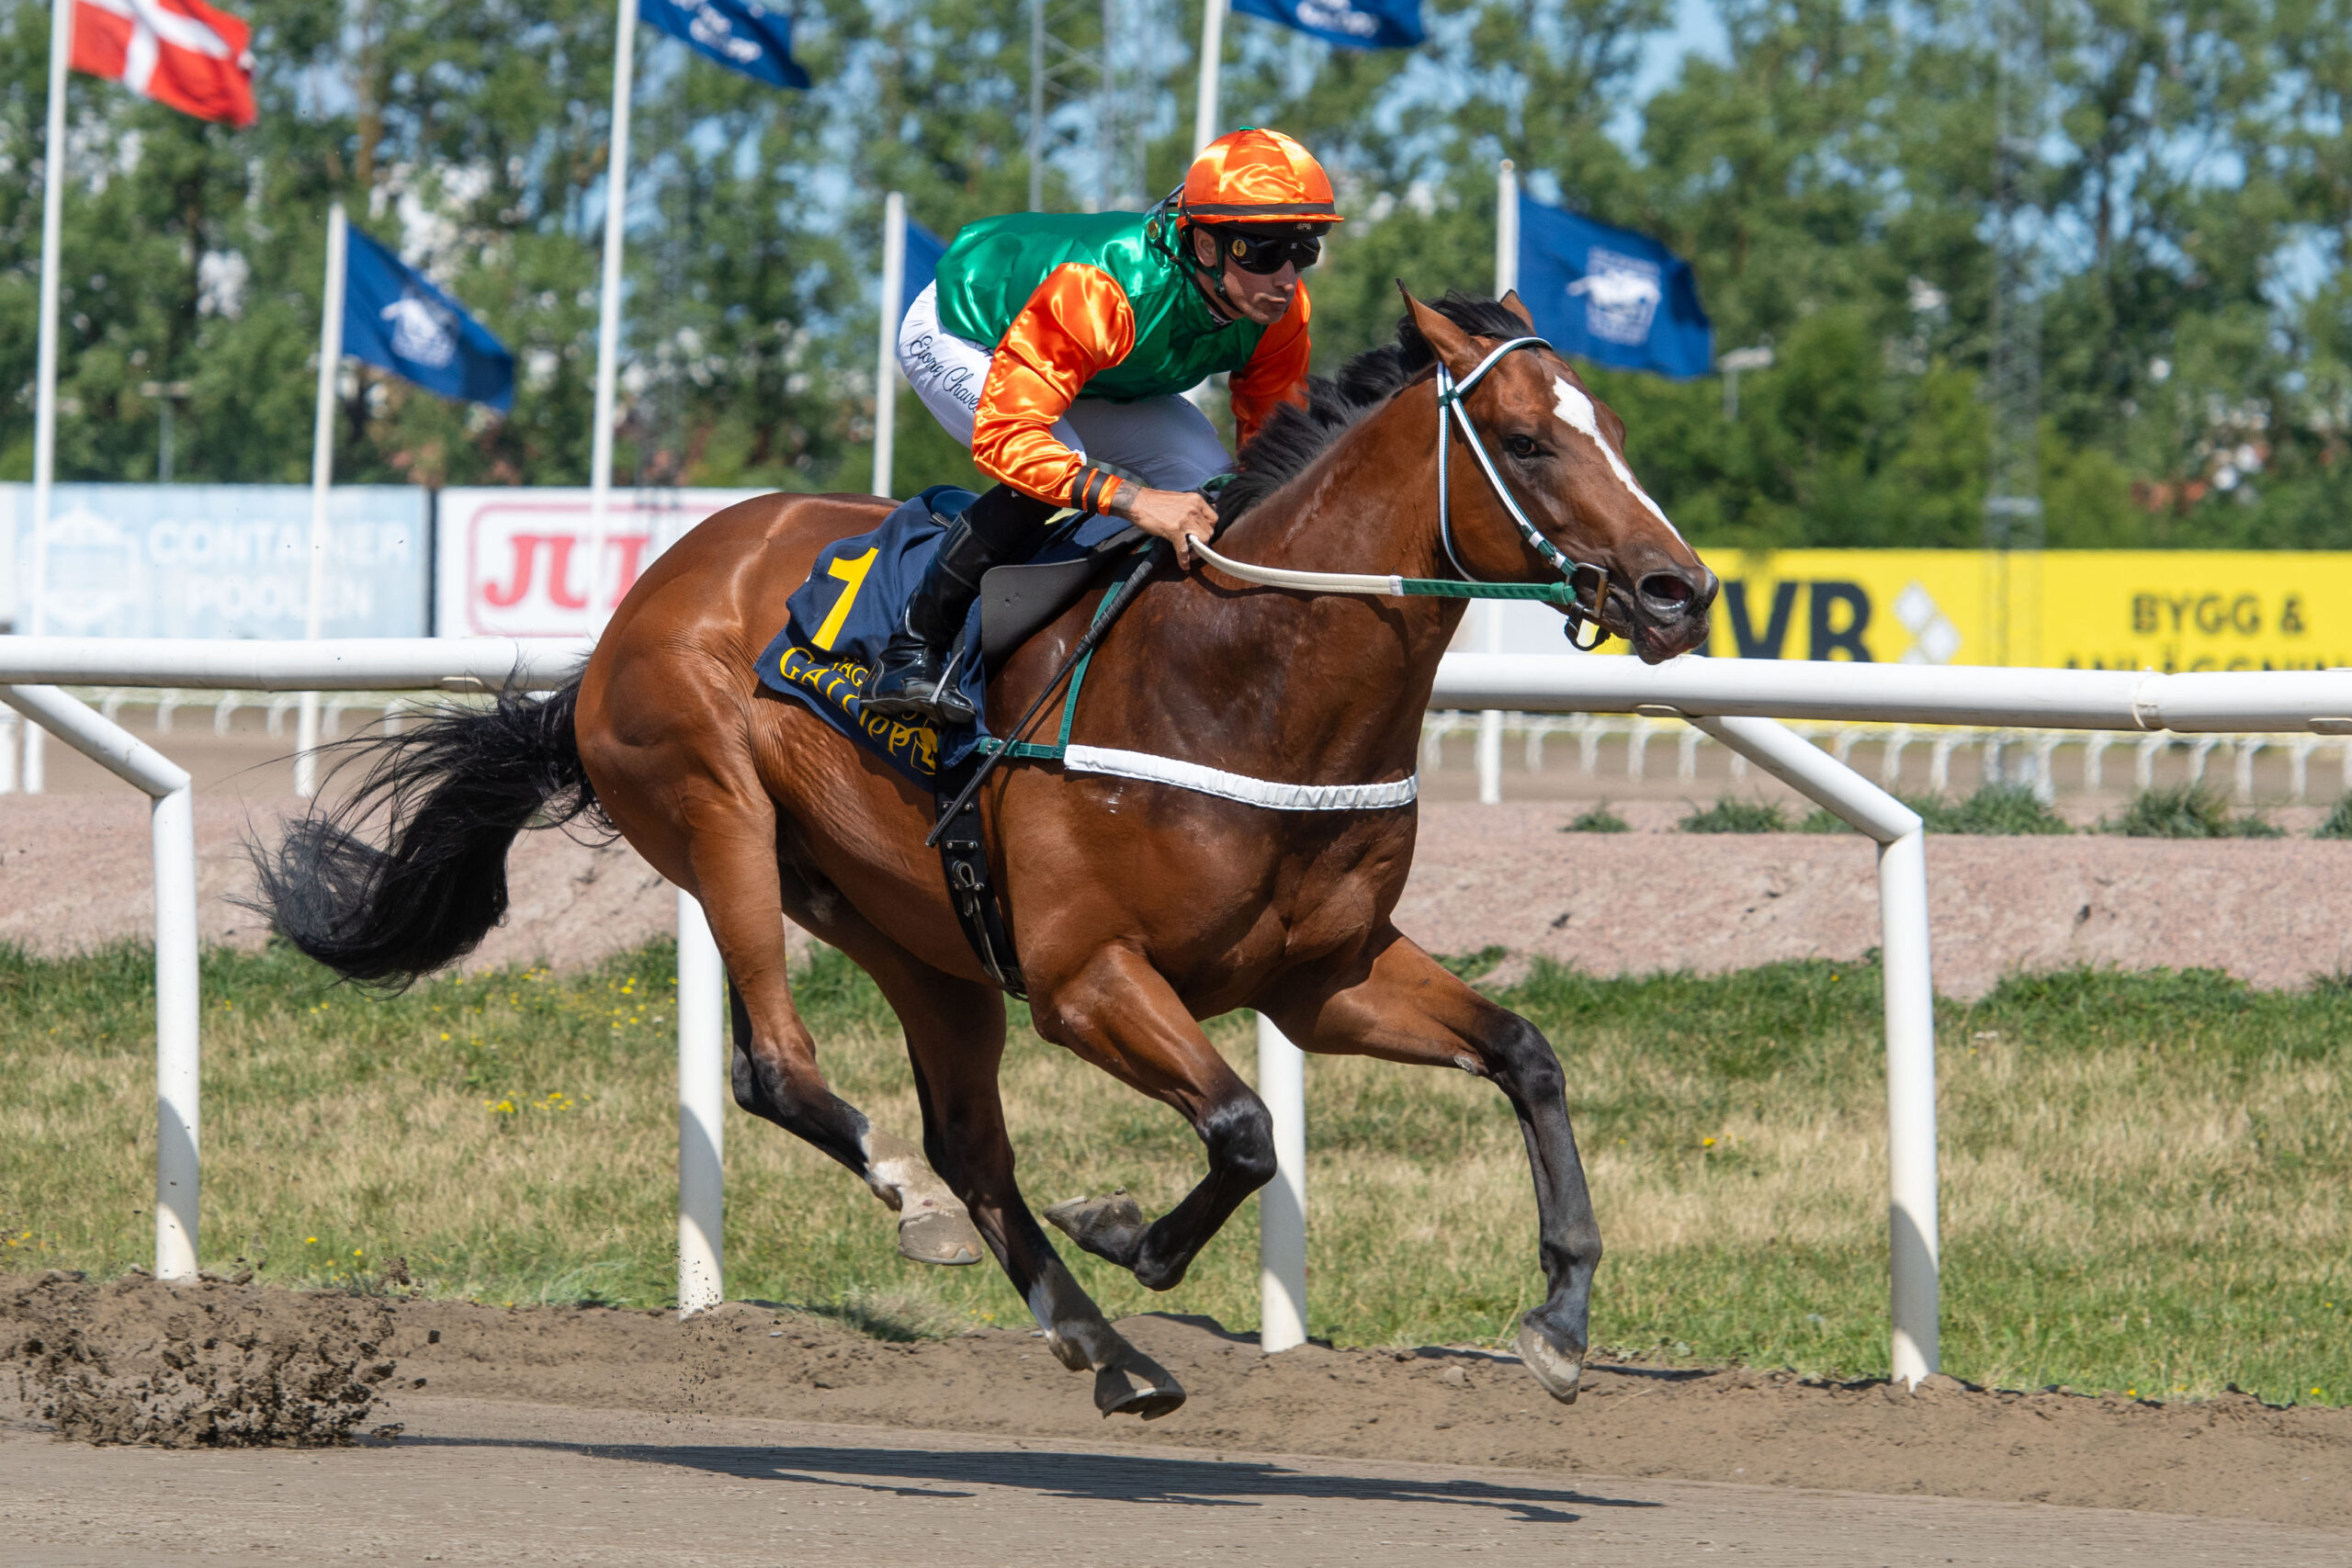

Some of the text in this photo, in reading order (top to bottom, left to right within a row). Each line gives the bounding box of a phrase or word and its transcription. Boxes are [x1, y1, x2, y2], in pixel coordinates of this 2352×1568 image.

[943, 367, 980, 413] Chave
[149, 520, 411, 563] CONTANER
[810, 547, 879, 651] 1
[2131, 593, 2306, 635] BYGG &
